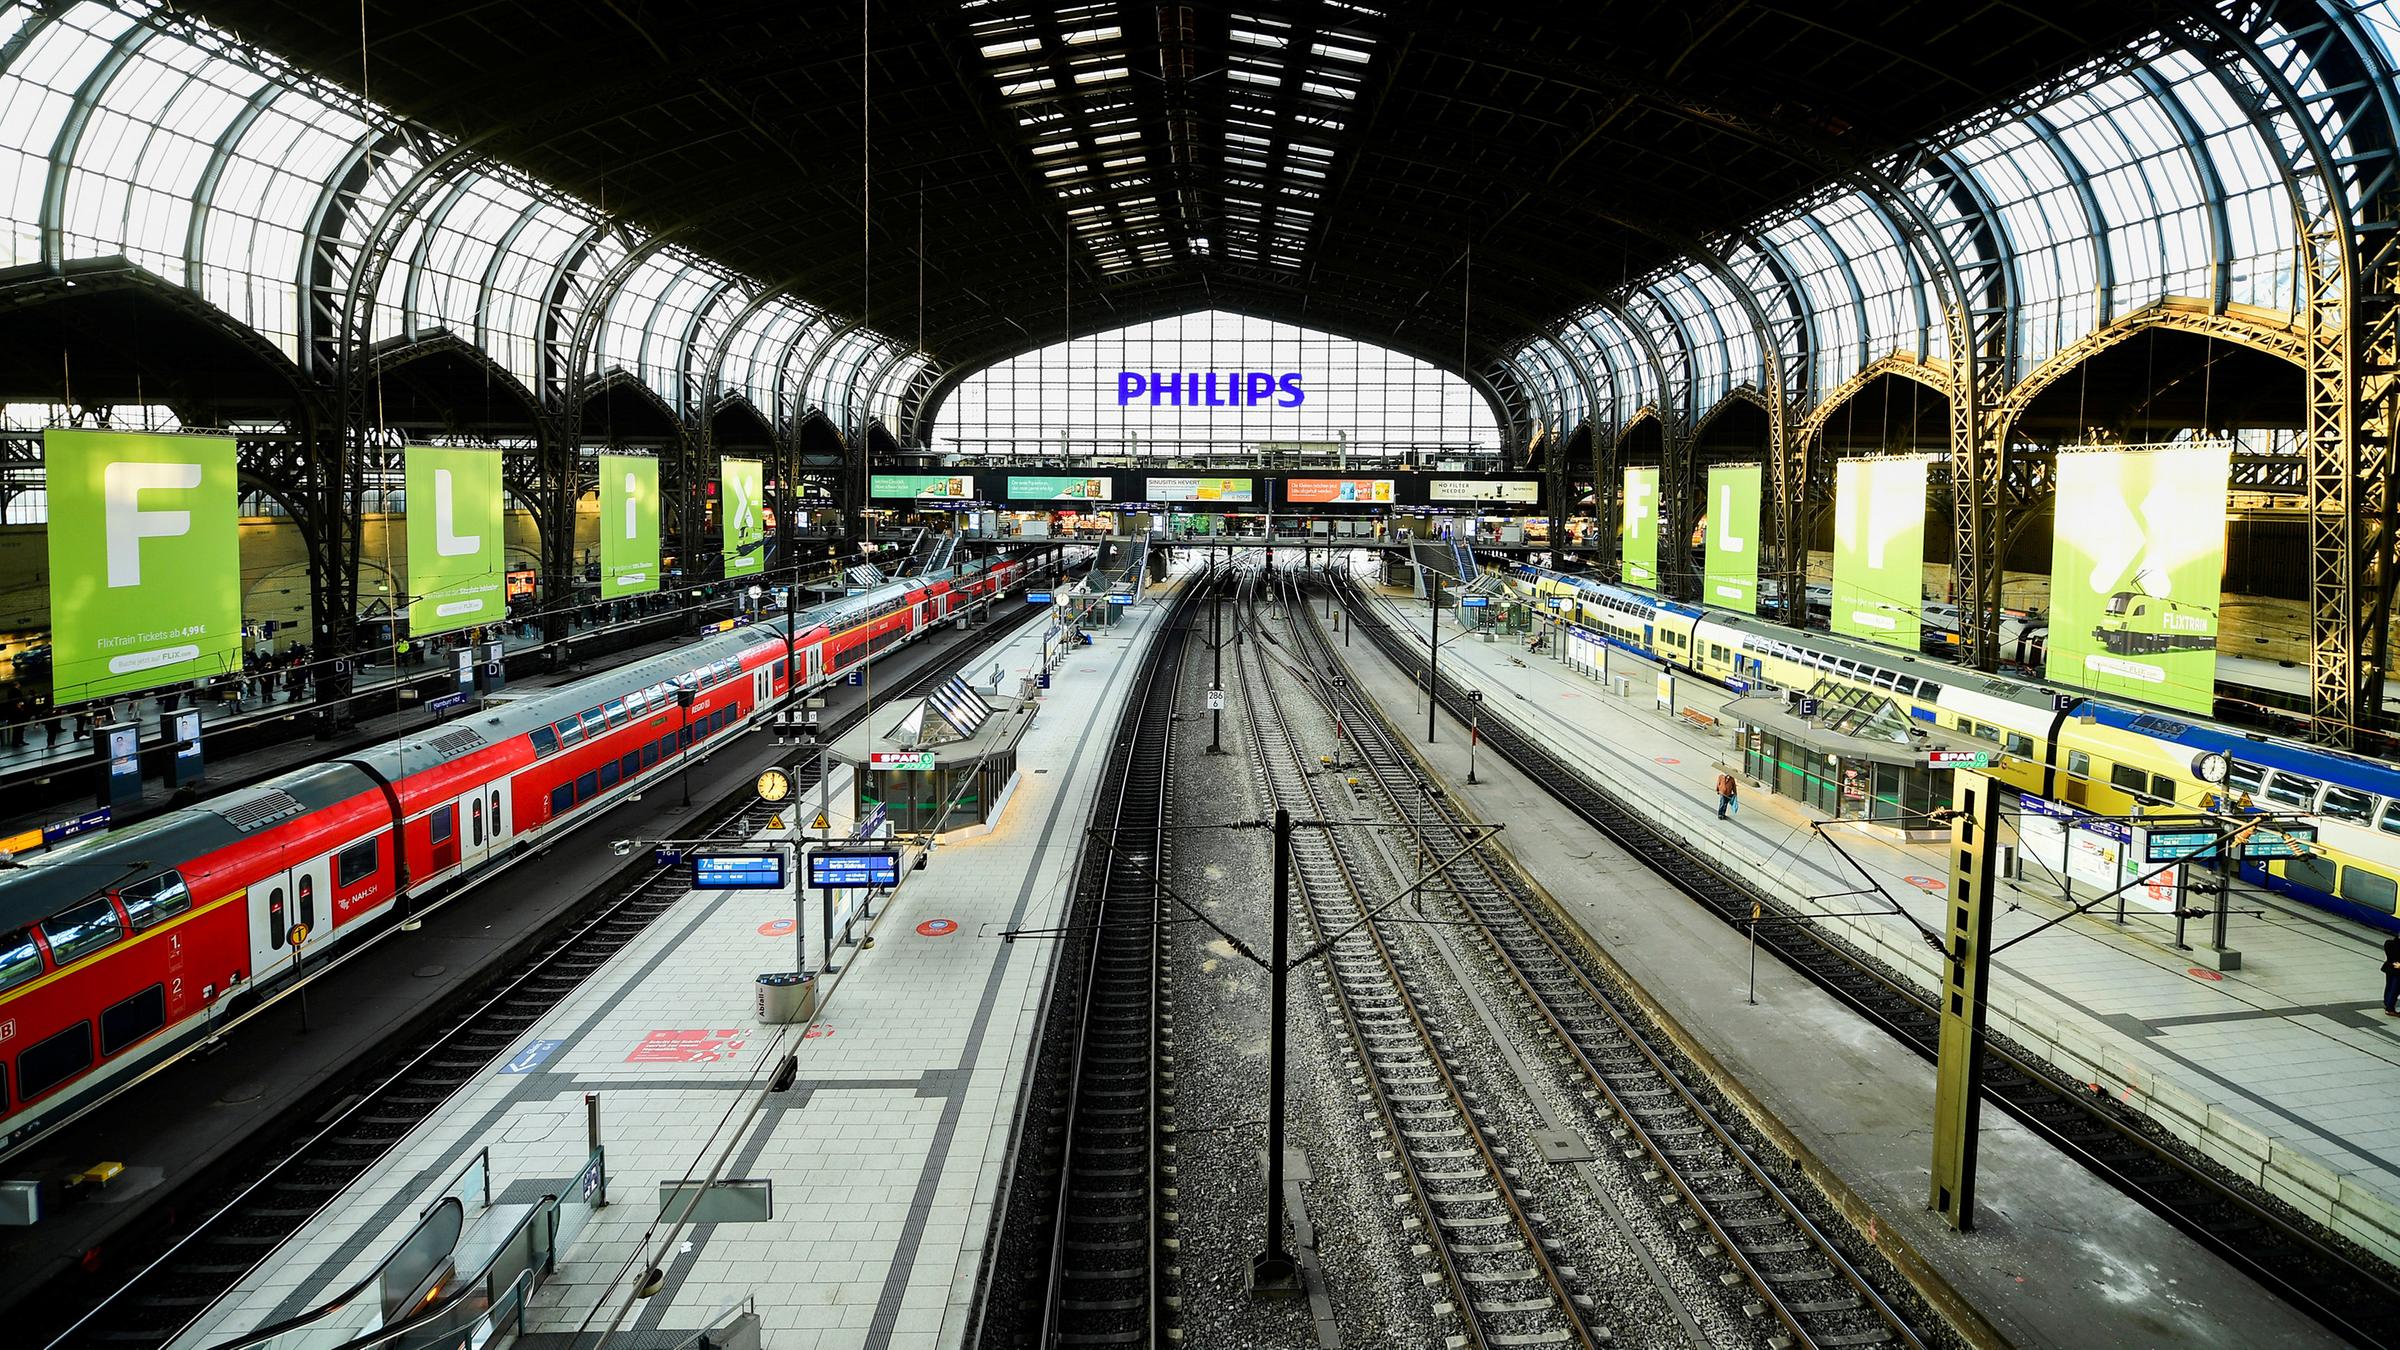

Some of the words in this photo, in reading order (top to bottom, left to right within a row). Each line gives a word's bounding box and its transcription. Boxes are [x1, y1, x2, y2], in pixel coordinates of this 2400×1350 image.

[1118, 371, 1305, 407] PHILIPS
[435, 469, 480, 556] L
[1719, 484, 1744, 553] L
[105, 462, 201, 588] F
[97, 636, 135, 649] FlixTrain
[138, 631, 168, 643] Tickets
[170, 628, 180, 638] ab
[335, 661, 345, 673] D
[488, 664, 498, 676] D
[849, 672, 857, 685] E
[1209, 691, 1223, 700] 286
[1212, 700, 1219, 708] 6
[1803, 700, 1812, 714] E
[2060, 696, 2069, 709] E
[880, 754, 919, 763] SPAR
[1939, 752, 1976, 761] SPAR
[887, 856, 894, 866] 8
[2258, 860, 2267, 873] 2
[172, 977, 182, 994] 2
